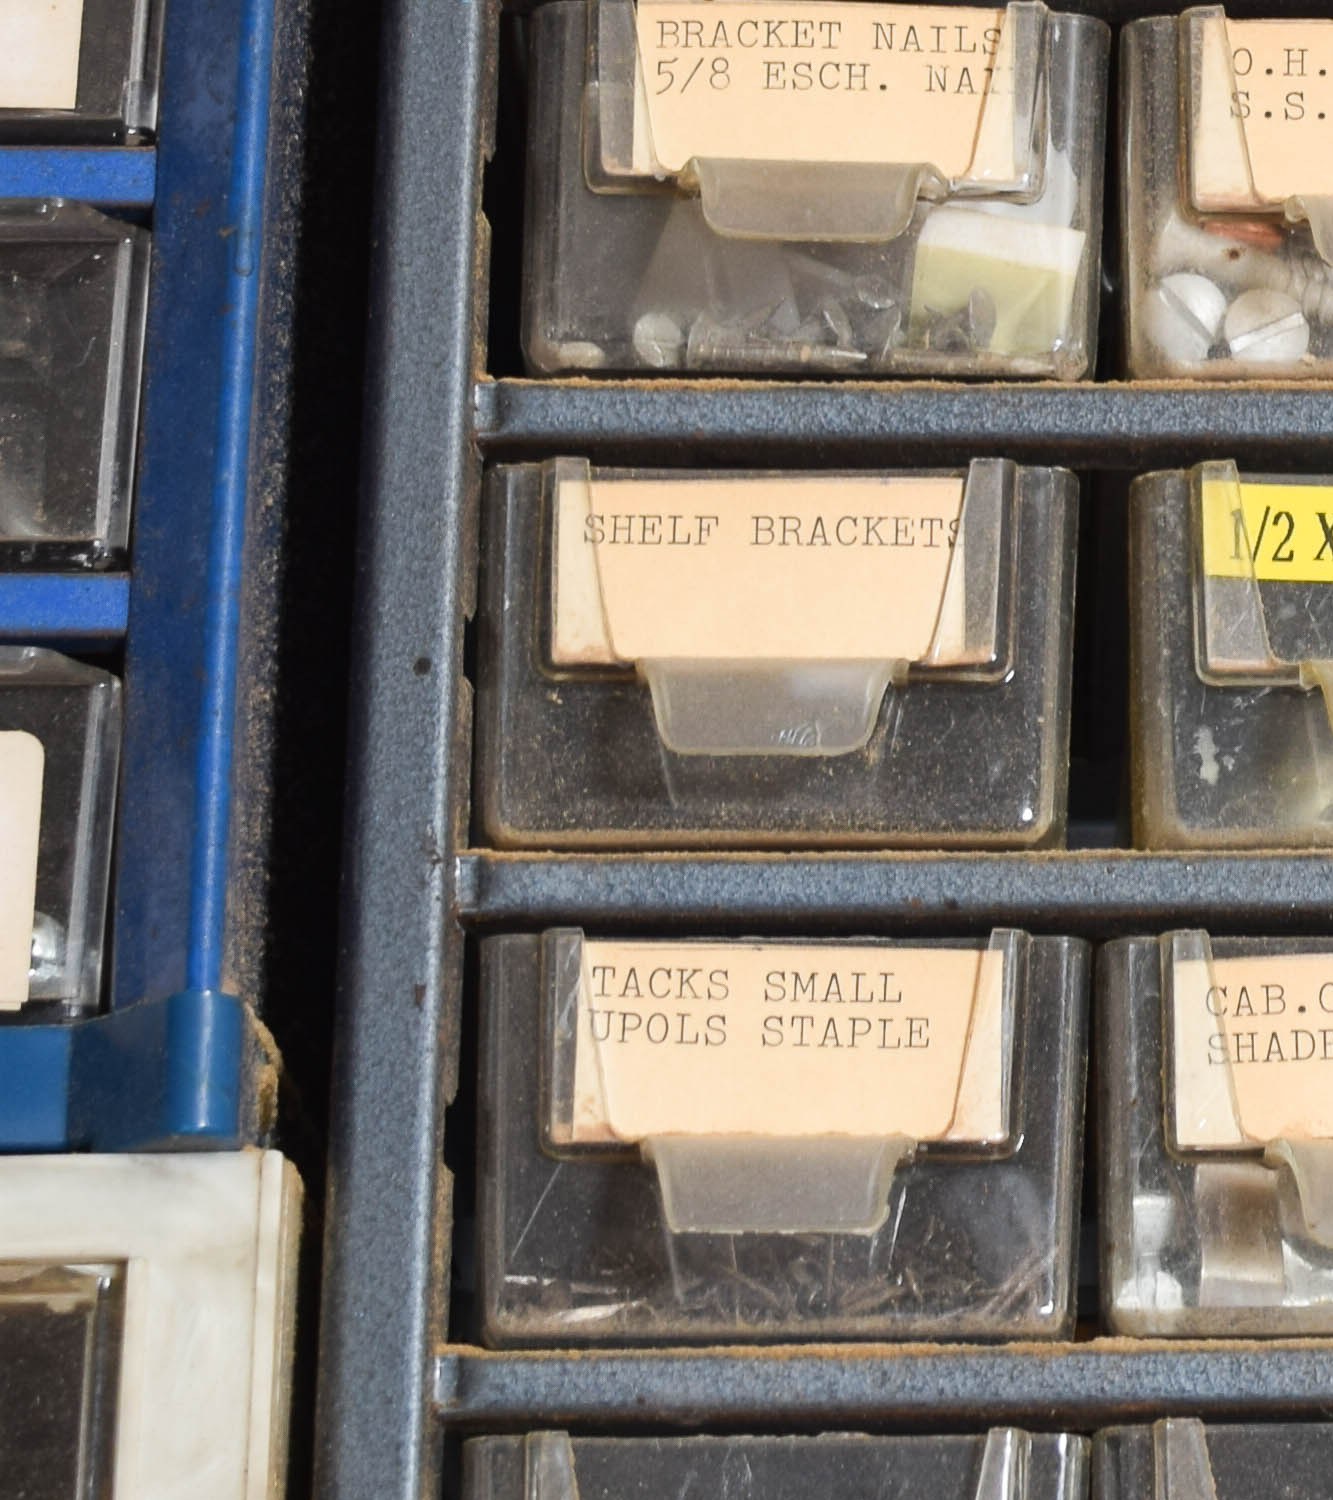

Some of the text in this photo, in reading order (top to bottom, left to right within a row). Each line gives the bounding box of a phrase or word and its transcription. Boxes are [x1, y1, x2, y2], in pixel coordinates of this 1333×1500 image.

[656, 20, 1002, 57] BRACKET NAILS
[656, 56, 888, 95] 5/8 ESCH.
[1229, 91, 1326, 121] S.S.
[583, 514, 720, 546] SHELF
[1229, 505, 1296, 563] 1/2
[591, 966, 903, 1004] TACKS SMALL
[588, 1008, 931, 1050] UPOLS STAPLE
